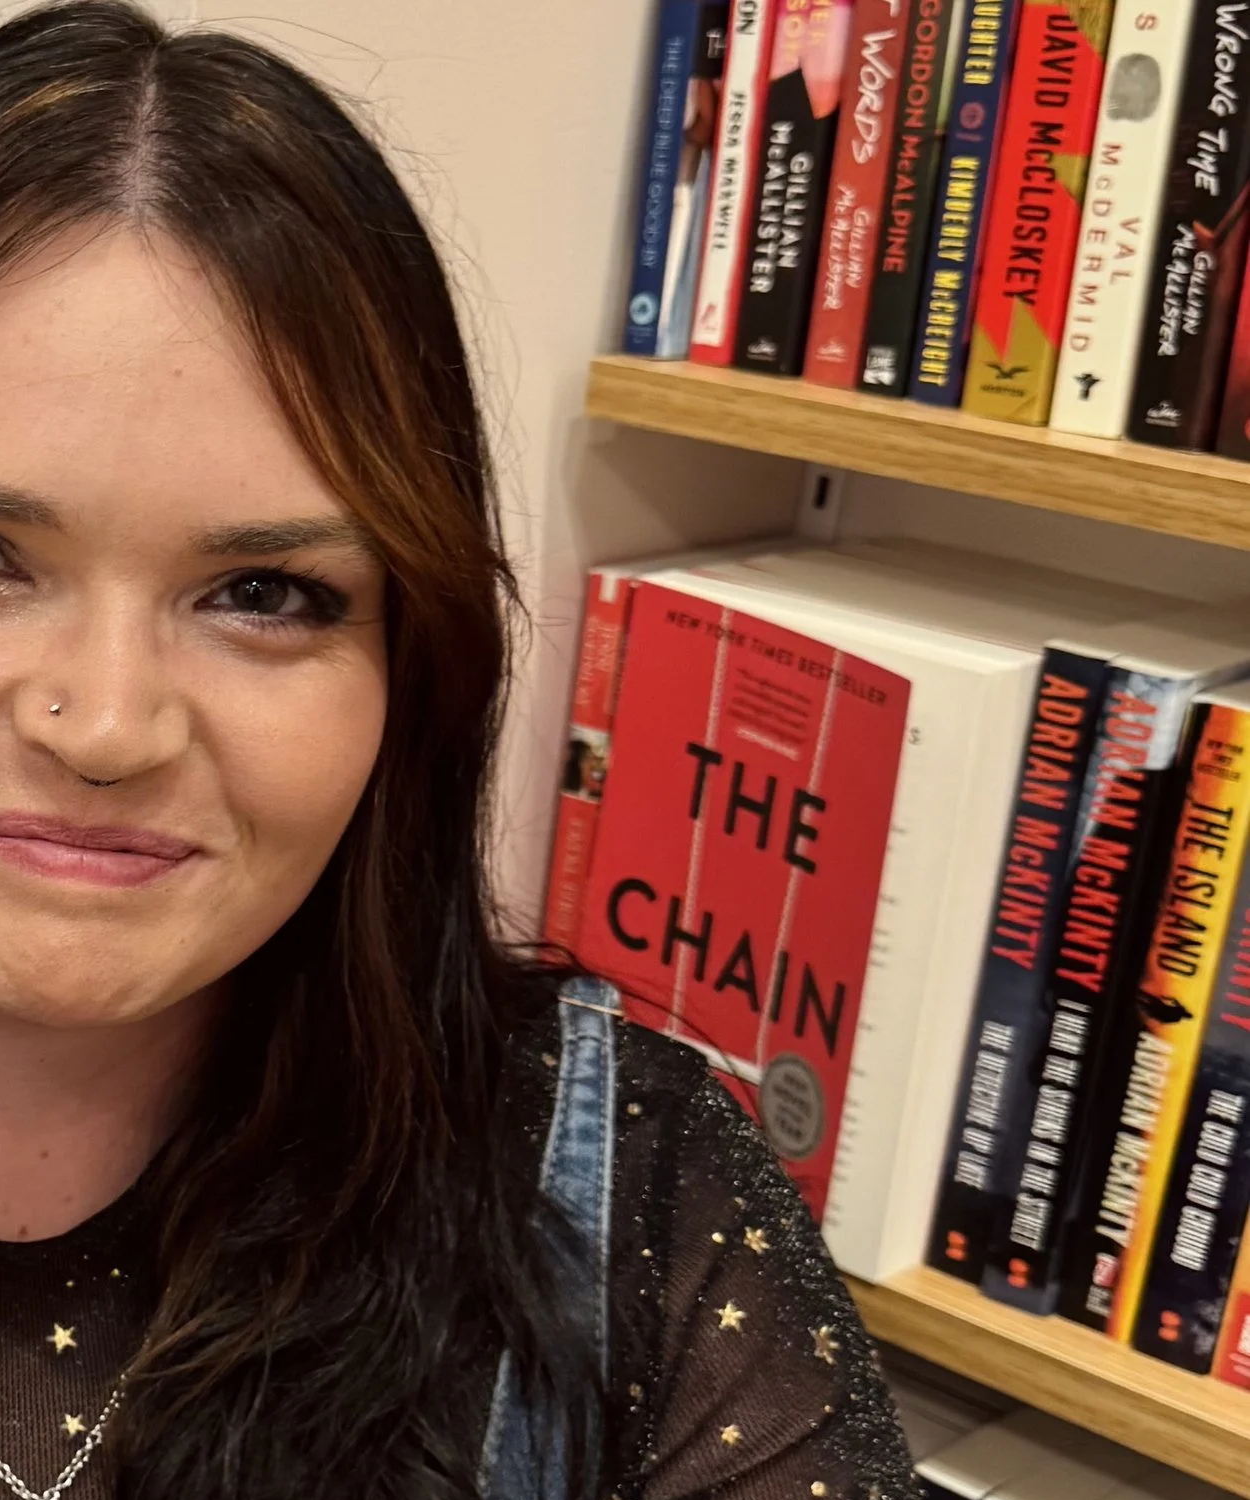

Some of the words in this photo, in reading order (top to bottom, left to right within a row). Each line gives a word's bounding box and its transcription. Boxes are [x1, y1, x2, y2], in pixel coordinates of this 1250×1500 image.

[851, 29, 897, 165] WORDS
[1034, 14, 1079, 109] DAVID
[1207, 3, 1250, 117] WRONG
[724, 90, 747, 148] JESSA
[1187, 127, 1230, 197] TIME
[712, 157, 737, 250] MAXWELL
[750, 120, 794, 293] McALLISTER
[778, 151, 815, 268] GILLIAN
[883, 135, 921, 274] McALPINE
[1069, 143, 1123, 353] McDERMID
[1109, 216, 1142, 285] VAL
[1157, 223, 1196, 356] McALLISTER
[1182, 250, 1216, 335] GILLIAN
[664, 610, 701, 629] NEW
[704, 623, 747, 648] YORK
[750, 638, 794, 667] TIMES
[797, 656, 888, 707] BESTSELLER
[1020, 673, 1090, 811] ADRIAN
[1090, 690, 1159, 831] ADRIAN
[686, 741, 826, 875] THE
[1180, 802, 1234, 861] THE
[991, 814, 1062, 971] McKINTY
[1056, 835, 1132, 994] McKINTY
[1155, 863, 1221, 980] ISLAND
[607, 878, 846, 1058] CHAIN
[1120, 1031, 1172, 1133] ADRIAN
